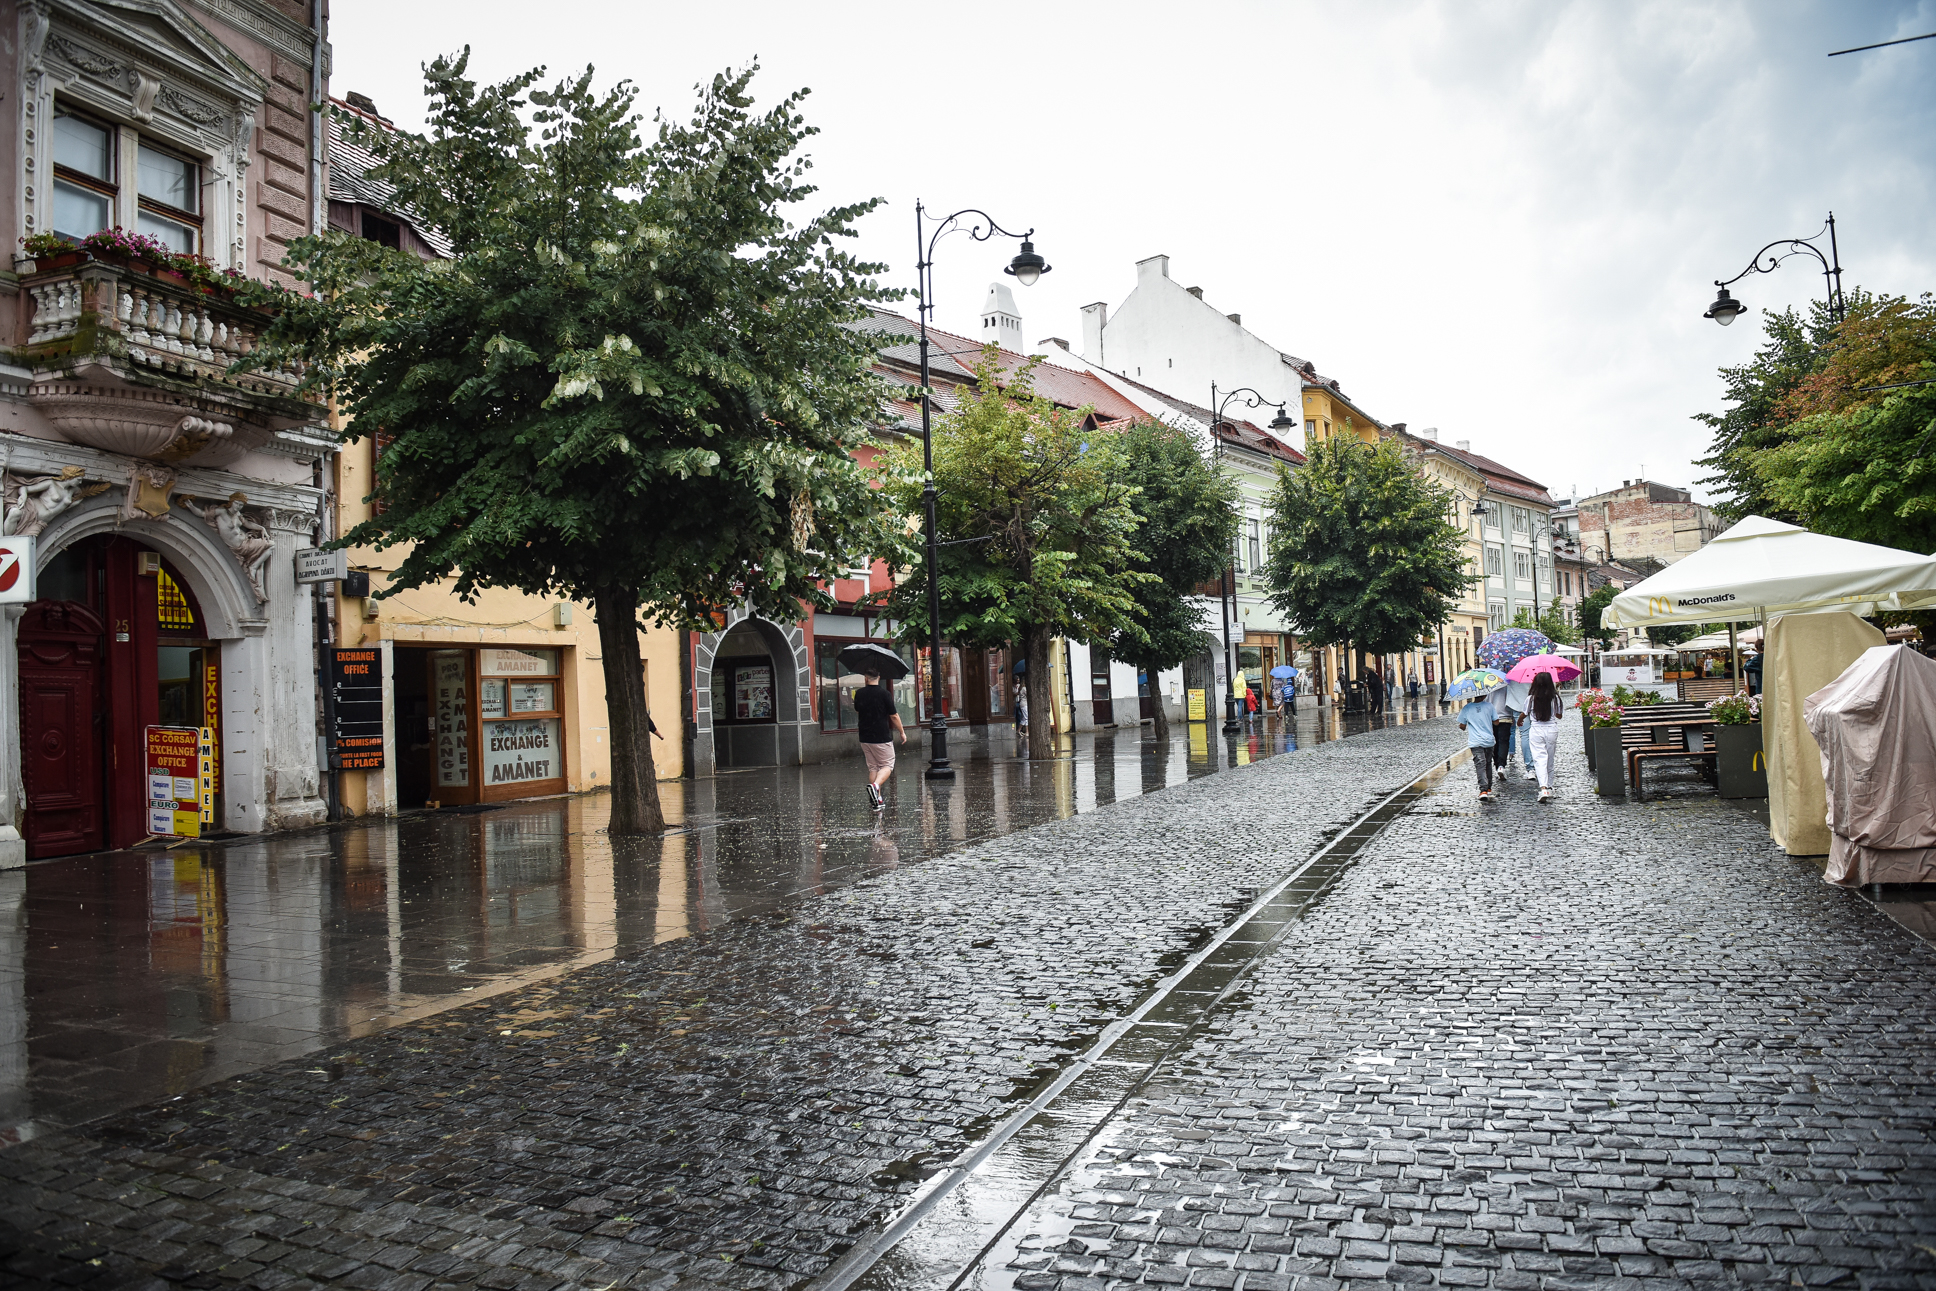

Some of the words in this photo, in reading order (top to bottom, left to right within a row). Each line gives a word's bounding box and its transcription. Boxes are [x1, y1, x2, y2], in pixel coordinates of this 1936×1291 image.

[305, 559, 328, 567] AVOCAT
[1678, 593, 1736, 607] McDonald's
[116, 619, 129, 632] 25
[337, 652, 375, 661] EXCHANGE
[496, 650, 538, 660] EXCHANGE
[344, 664, 369, 674] OFFICE
[496, 661, 538, 672] AMANET
[149, 735, 160, 743] SC
[162, 735, 196, 744] CORSAV
[439, 688, 454, 781] EXCHANGE
[454, 687, 468, 781] AMANET
[346, 738, 382, 747] COMISION
[491, 735, 549, 752] EXCHANGE
[150, 745, 196, 757] EXCHANGE
[157, 756, 187, 768] OFFICE
[150, 767, 170, 775] USD
[203, 729, 211, 821] AMANET
[491, 760, 550, 783] AMANET
[150, 800, 179, 810] EURO
